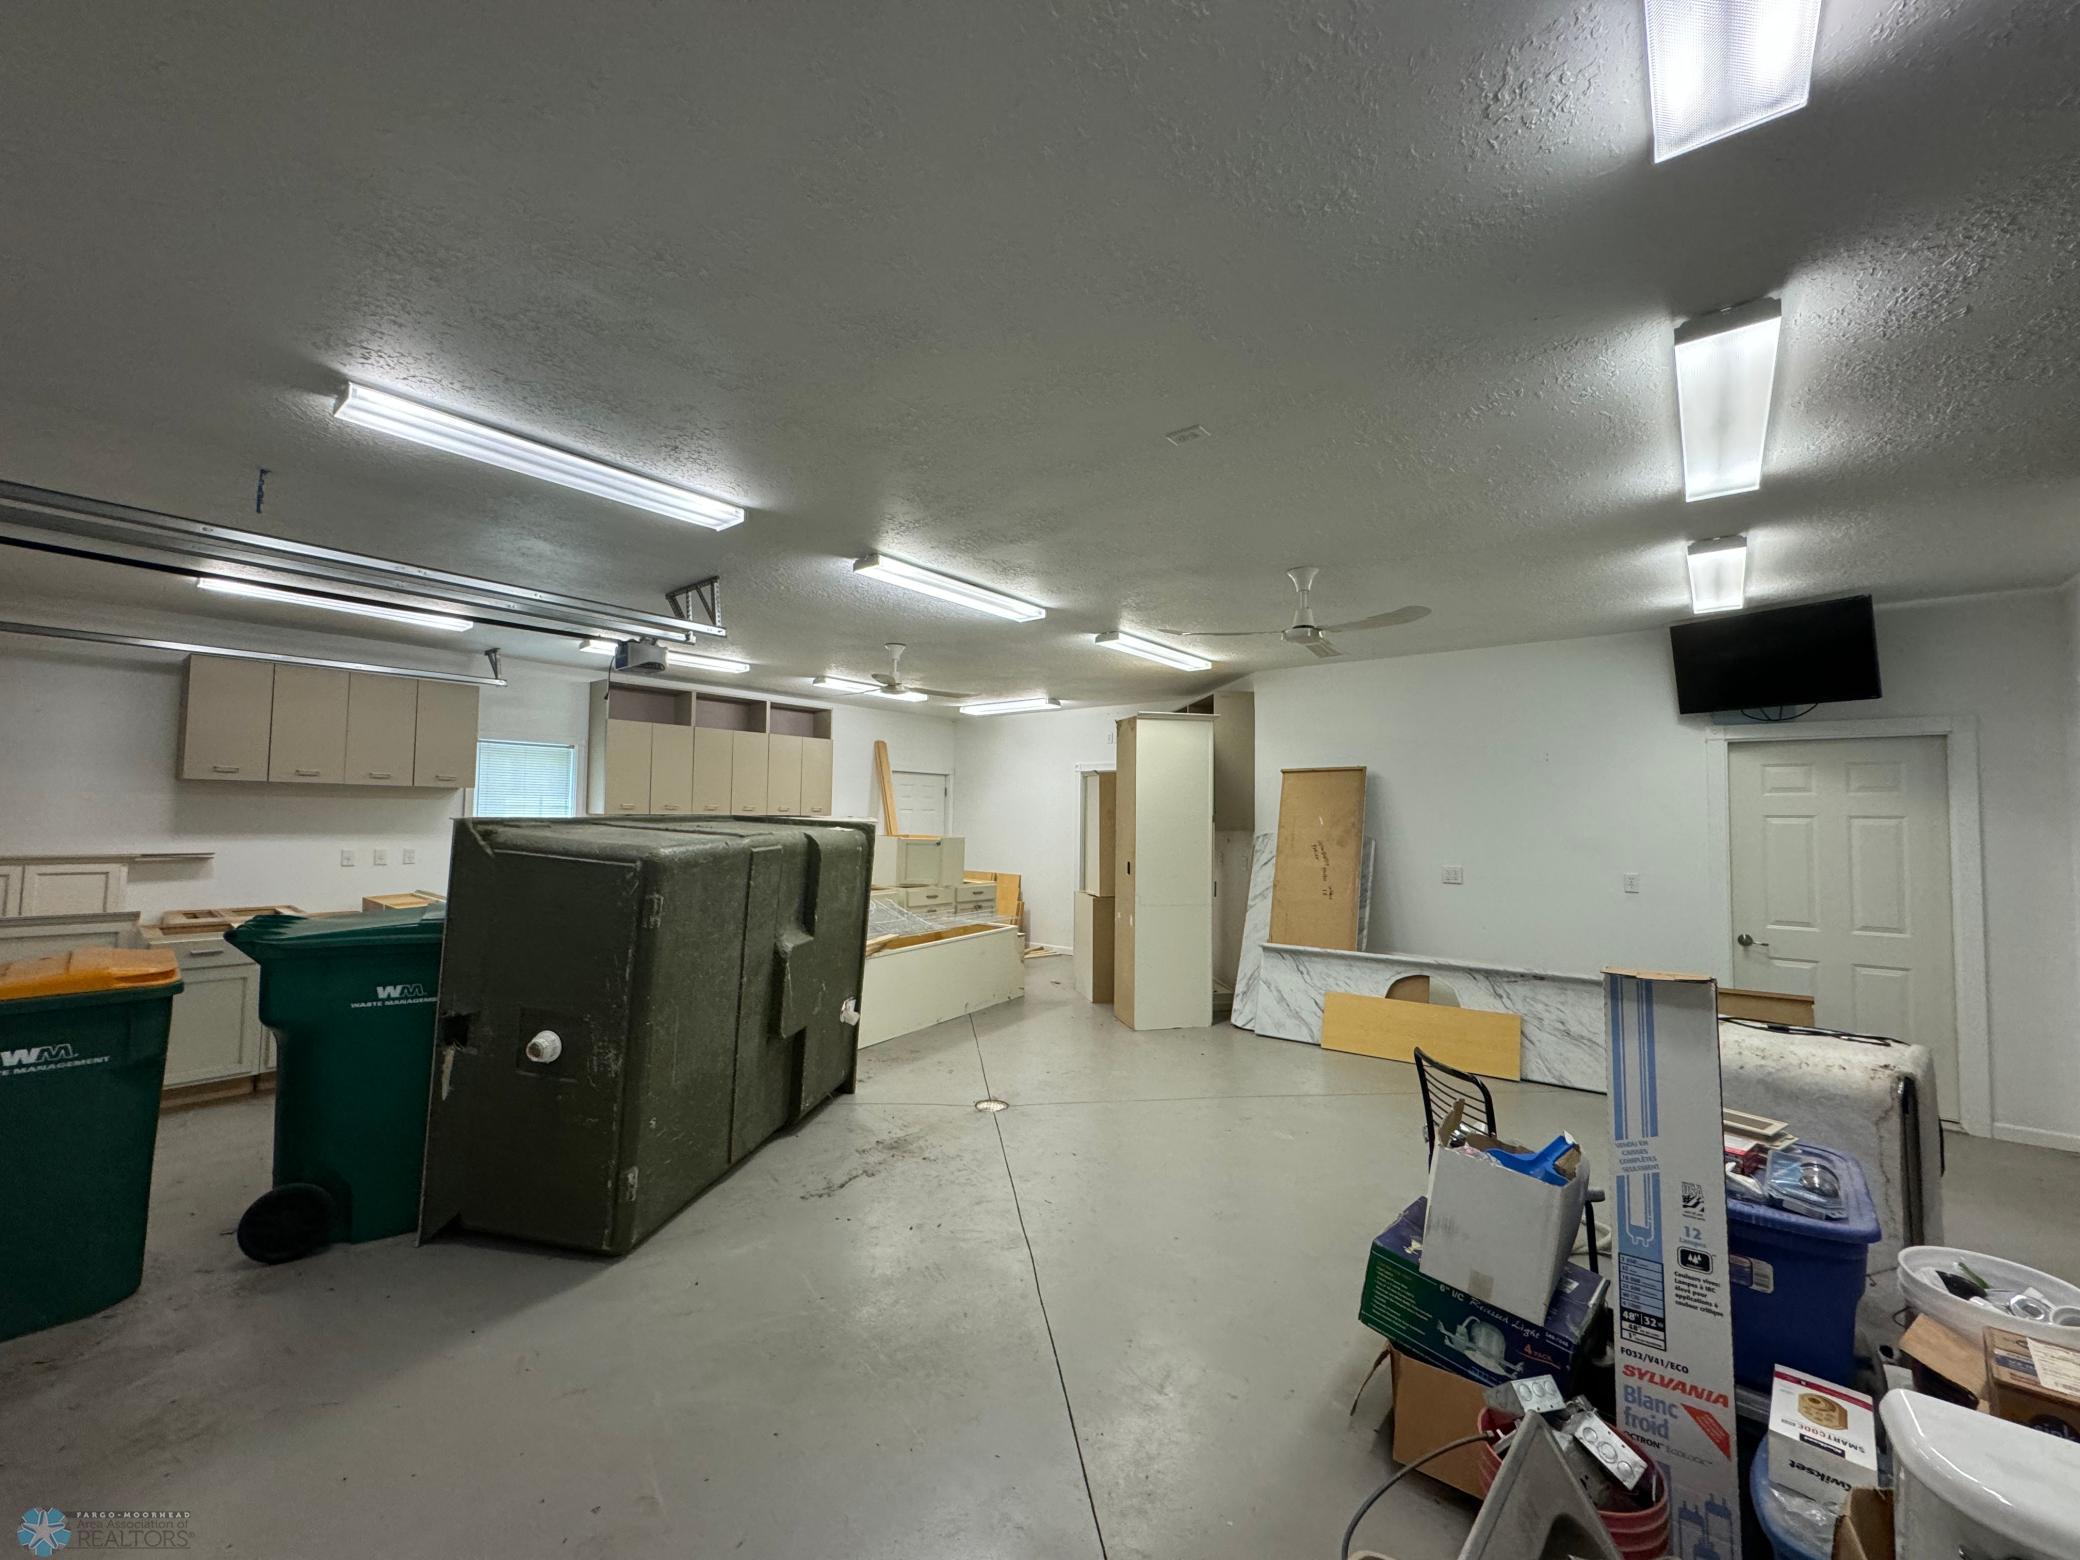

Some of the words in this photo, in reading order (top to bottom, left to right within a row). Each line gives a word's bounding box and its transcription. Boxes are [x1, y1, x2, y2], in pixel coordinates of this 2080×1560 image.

[376, 984, 424, 999] WM
[13, 1056, 110, 1075] MANAGEMENT
[1684, 1226, 1702, 1240] 12
[1511, 1320, 1541, 1339] Light
[1524, 1344, 1533, 1355] 4
[1622, 1364, 1729, 1408] SYLVANIA
[1623, 1384, 1679, 1419] Blanc
[1623, 1405, 1670, 1440] froid
[1799, 1423, 1865, 1454] SMARTCODE
